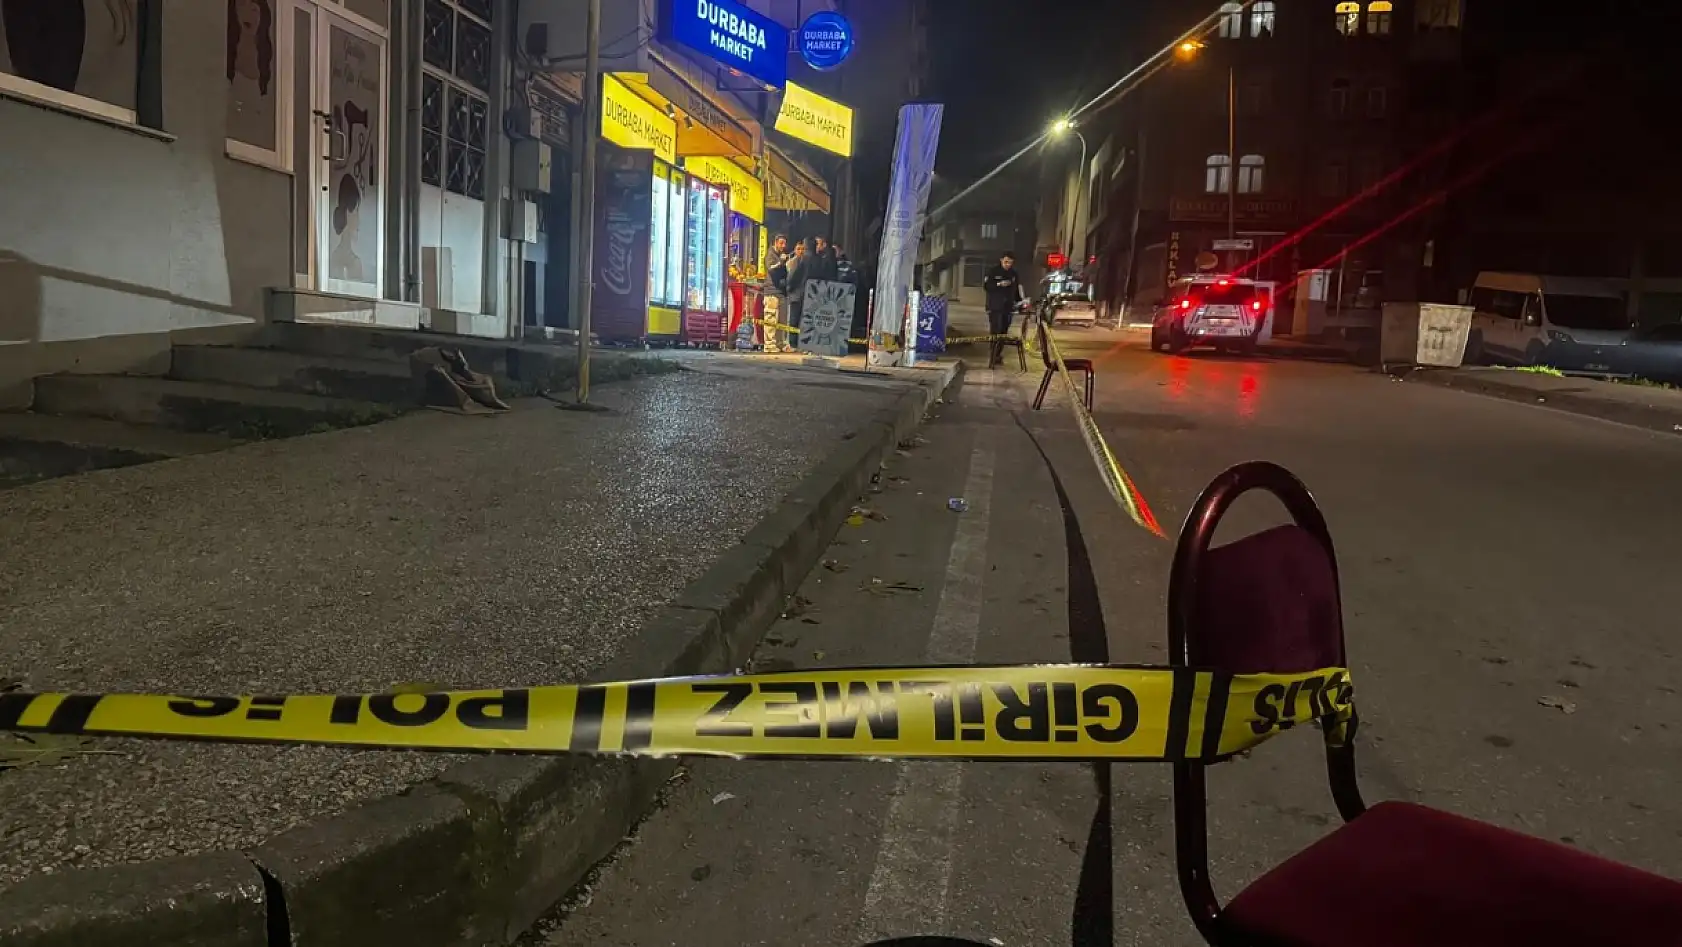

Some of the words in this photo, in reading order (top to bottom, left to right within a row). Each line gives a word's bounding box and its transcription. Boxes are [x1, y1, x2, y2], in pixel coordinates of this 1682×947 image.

[697, 0, 766, 49] DURBABA
[804, 31, 846, 41] DURBABA
[710, 30, 754, 62] MARKET
[805, 40, 841, 51] MARKET
[605, 96, 644, 137] DURBABA
[643, 124, 673, 155] MARKET
[816, 115, 847, 140] MARKET
[1250, 672, 1353, 735] OLİS
